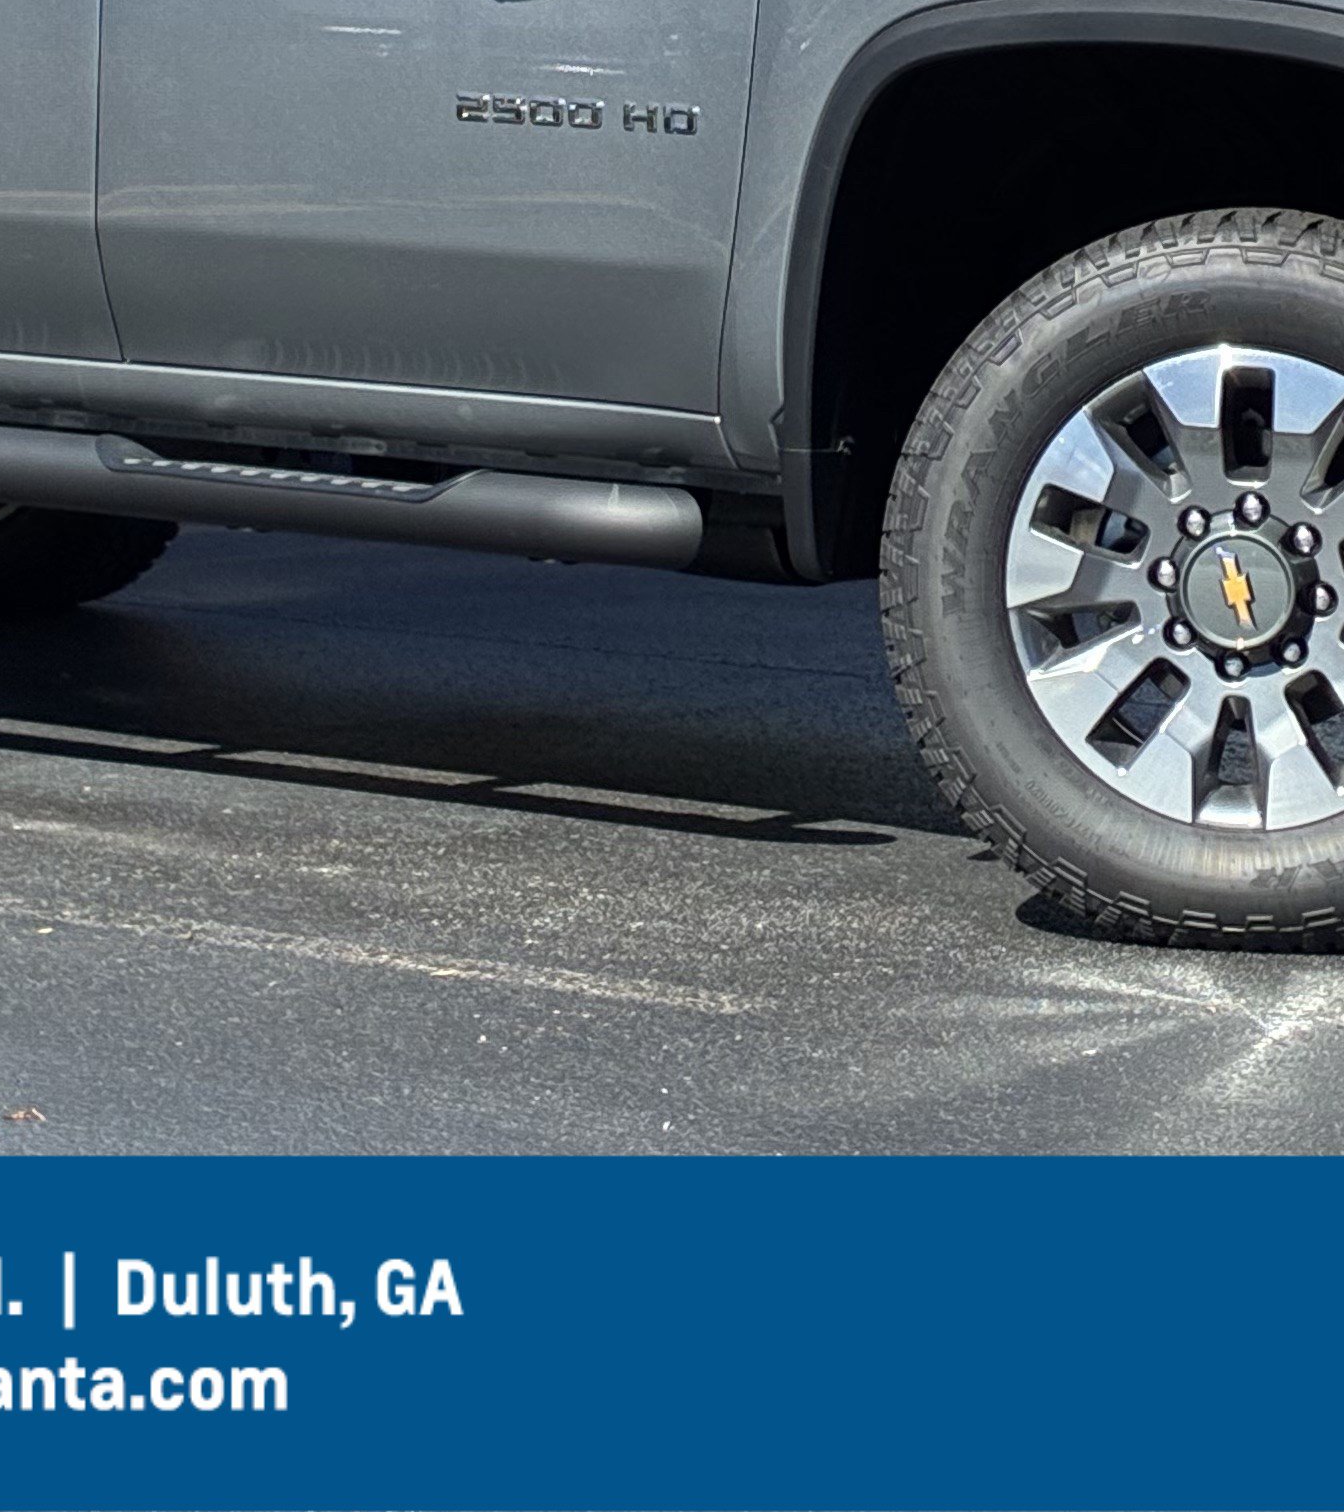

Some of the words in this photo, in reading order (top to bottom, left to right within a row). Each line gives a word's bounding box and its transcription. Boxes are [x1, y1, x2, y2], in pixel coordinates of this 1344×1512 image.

[455, 90, 605, 130] 2500
[623, 100, 701, 136] HD
[940, 290, 1216, 617] WRANGLER
